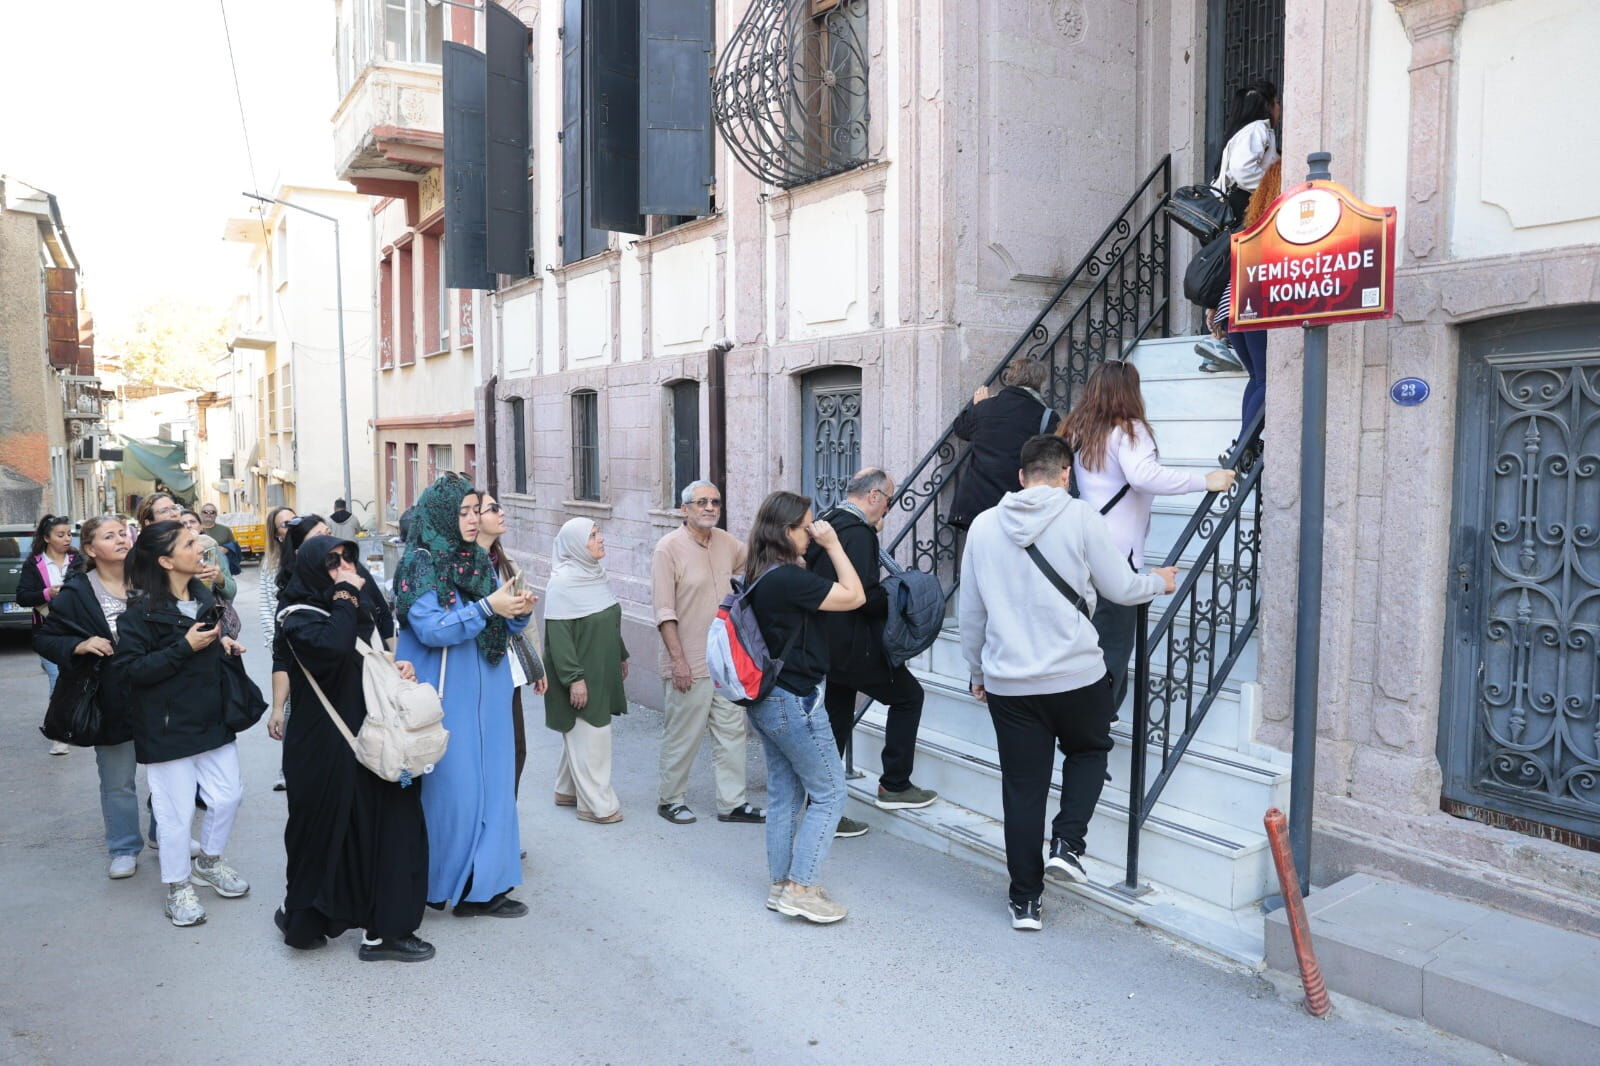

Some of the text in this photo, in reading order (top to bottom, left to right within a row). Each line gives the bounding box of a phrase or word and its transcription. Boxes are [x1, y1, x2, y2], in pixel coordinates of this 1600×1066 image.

[1246, 248, 1374, 282] YEMİŞÇİZADE
[1269, 274, 1340, 303] KONAĞI
[1400, 383, 1416, 397] 23
